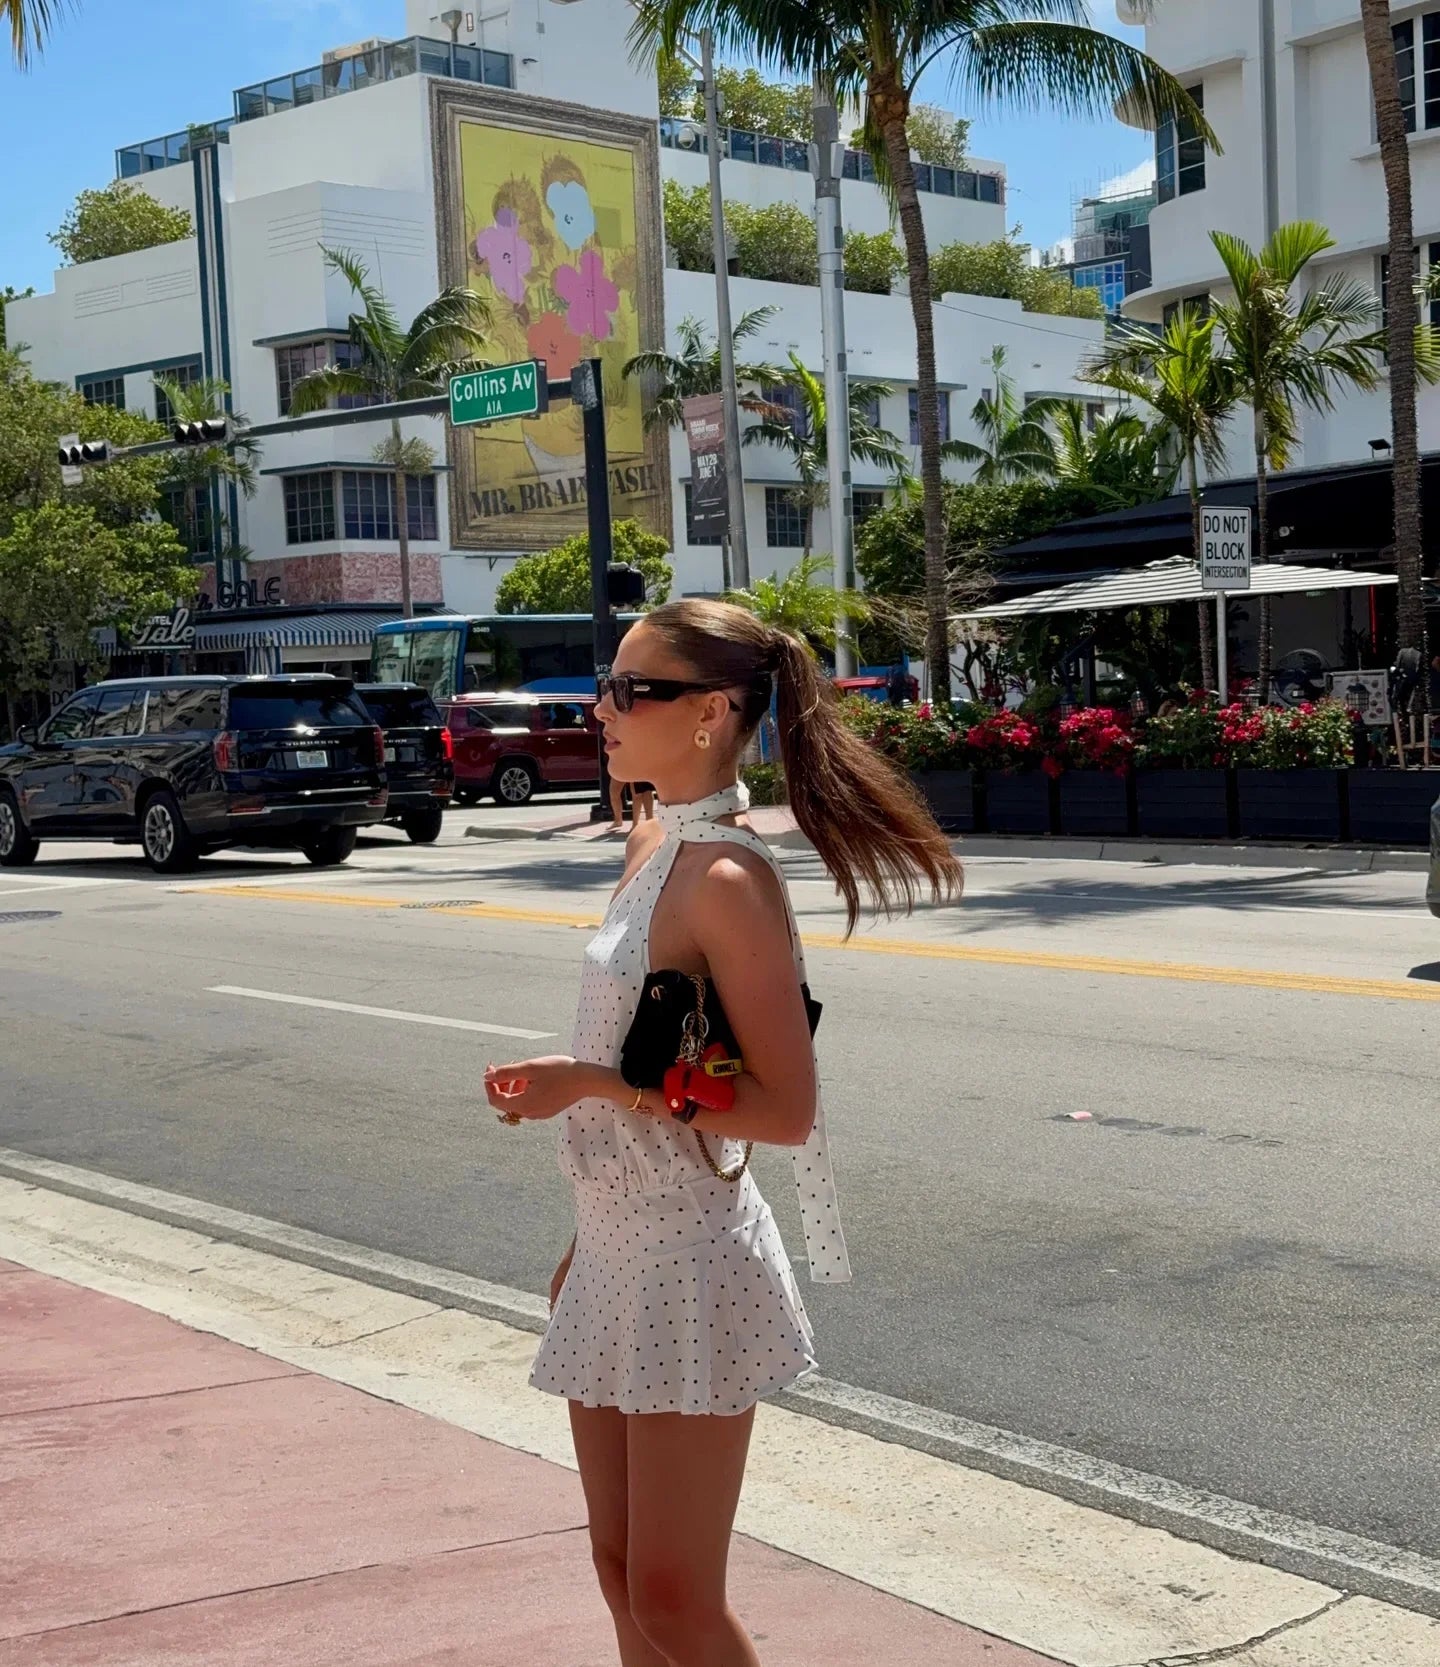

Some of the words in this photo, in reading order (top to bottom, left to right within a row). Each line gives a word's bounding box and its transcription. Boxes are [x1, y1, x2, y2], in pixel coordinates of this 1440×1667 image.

[453, 374, 507, 402] Collins
[511, 369, 533, 392] Av
[697, 456, 709, 468] MAY
[699, 466, 712, 480] JUNE
[469, 488, 515, 518] MR.
[1204, 515, 1220, 533] DO
[1223, 515, 1247, 534] NOT
[1206, 542, 1245, 560] BLOCK
[1205, 566, 1248, 578] INTERSECTION
[217, 577, 281, 608] GALE
